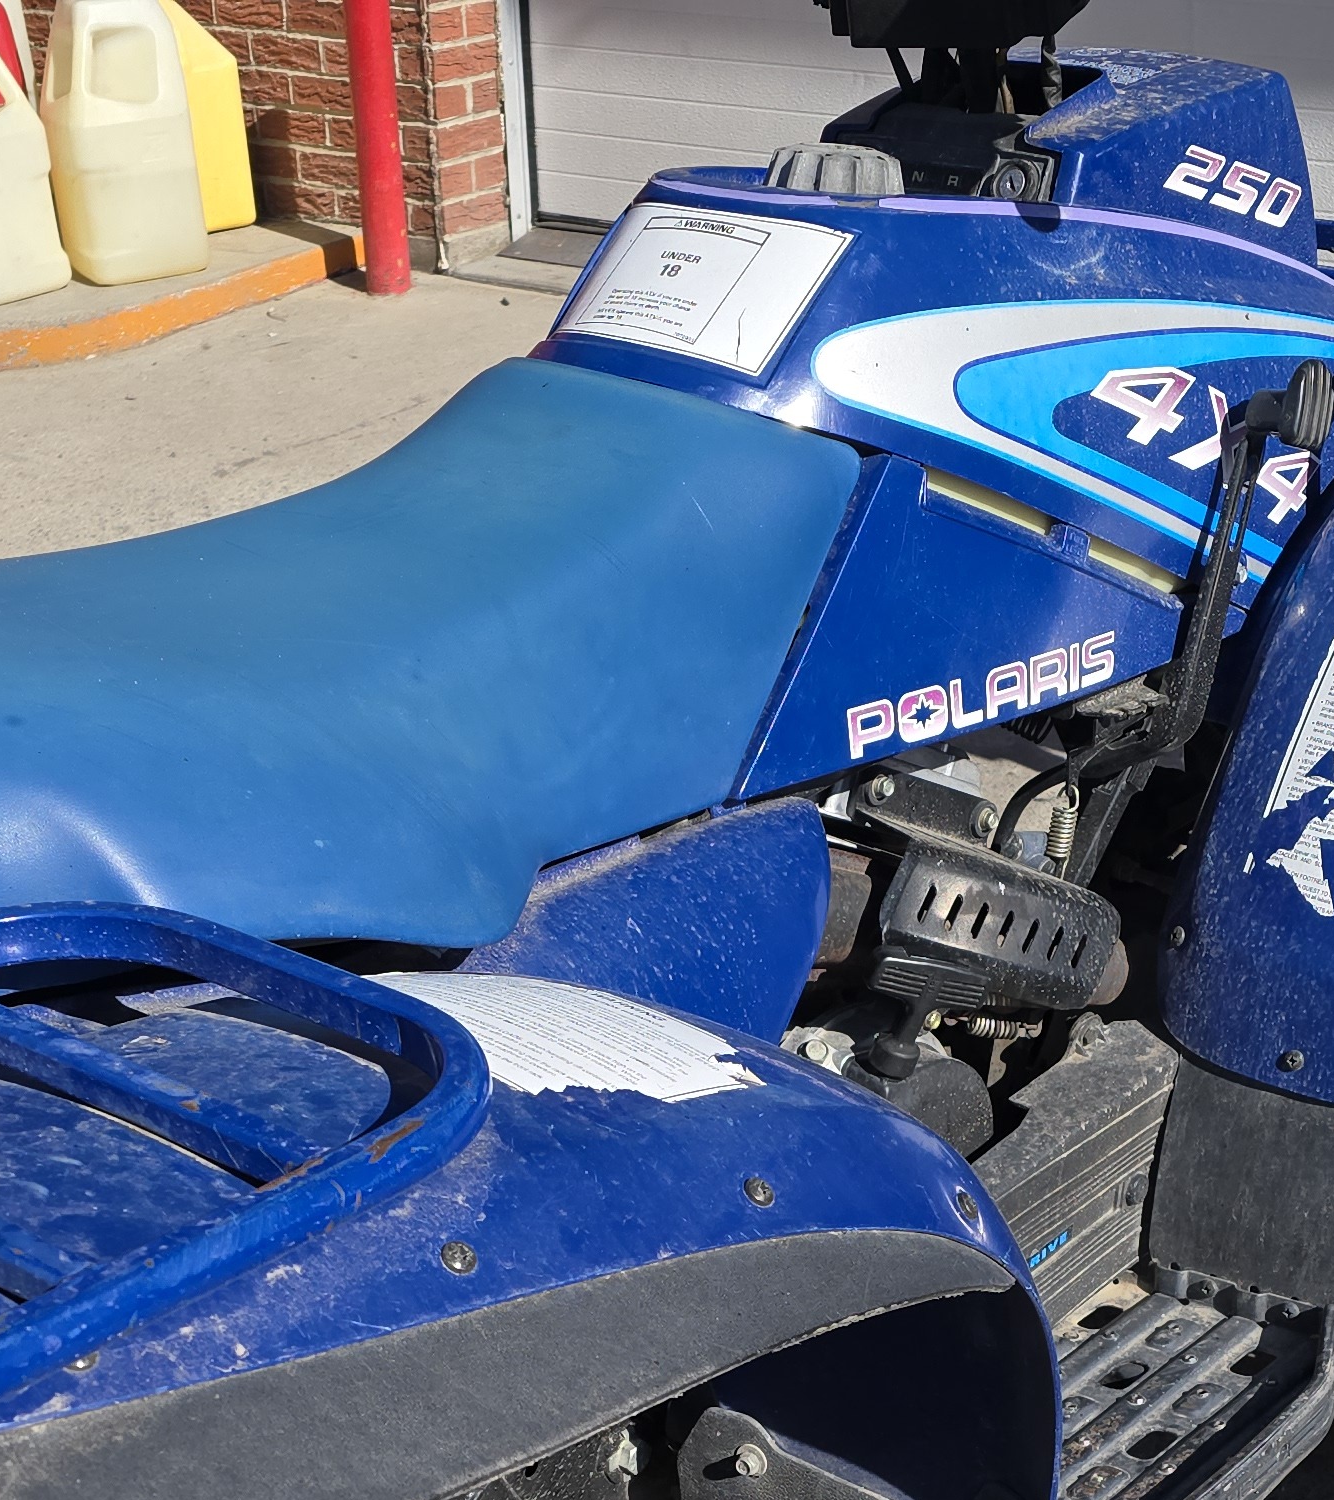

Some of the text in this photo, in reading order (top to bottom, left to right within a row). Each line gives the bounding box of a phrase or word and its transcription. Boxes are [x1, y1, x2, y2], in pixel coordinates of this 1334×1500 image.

[912, 171, 959, 187] N R
[1164, 145, 1302, 228] 250
[684, 219, 735, 234] WARNING
[661, 250, 702, 264] UNDER
[660, 264, 682, 278] 18
[846, 631, 1115, 759] POLARIS
[1029, 1231, 1068, 1269] RIVE
